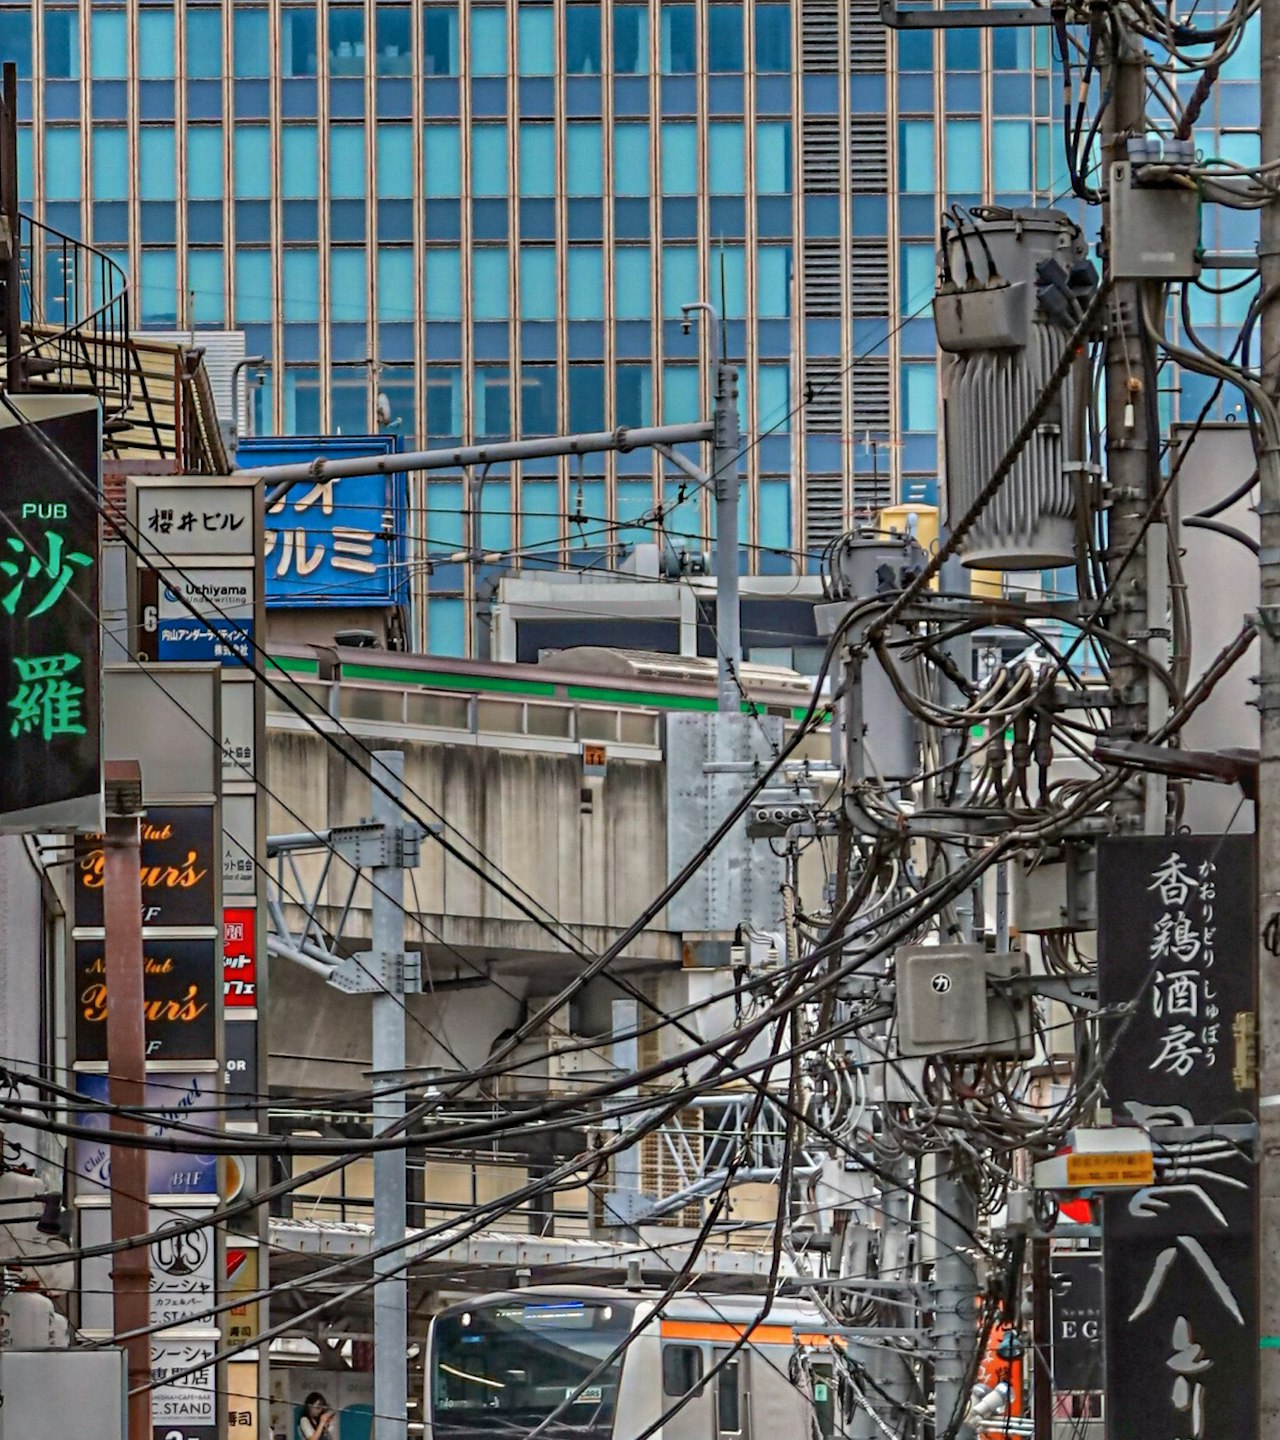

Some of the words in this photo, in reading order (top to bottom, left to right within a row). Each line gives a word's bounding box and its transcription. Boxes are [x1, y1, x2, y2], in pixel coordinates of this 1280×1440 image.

[22, 503, 68, 519] PUB
[80, 850, 207, 887] Yur's
[81, 983, 207, 1021] Yur's
